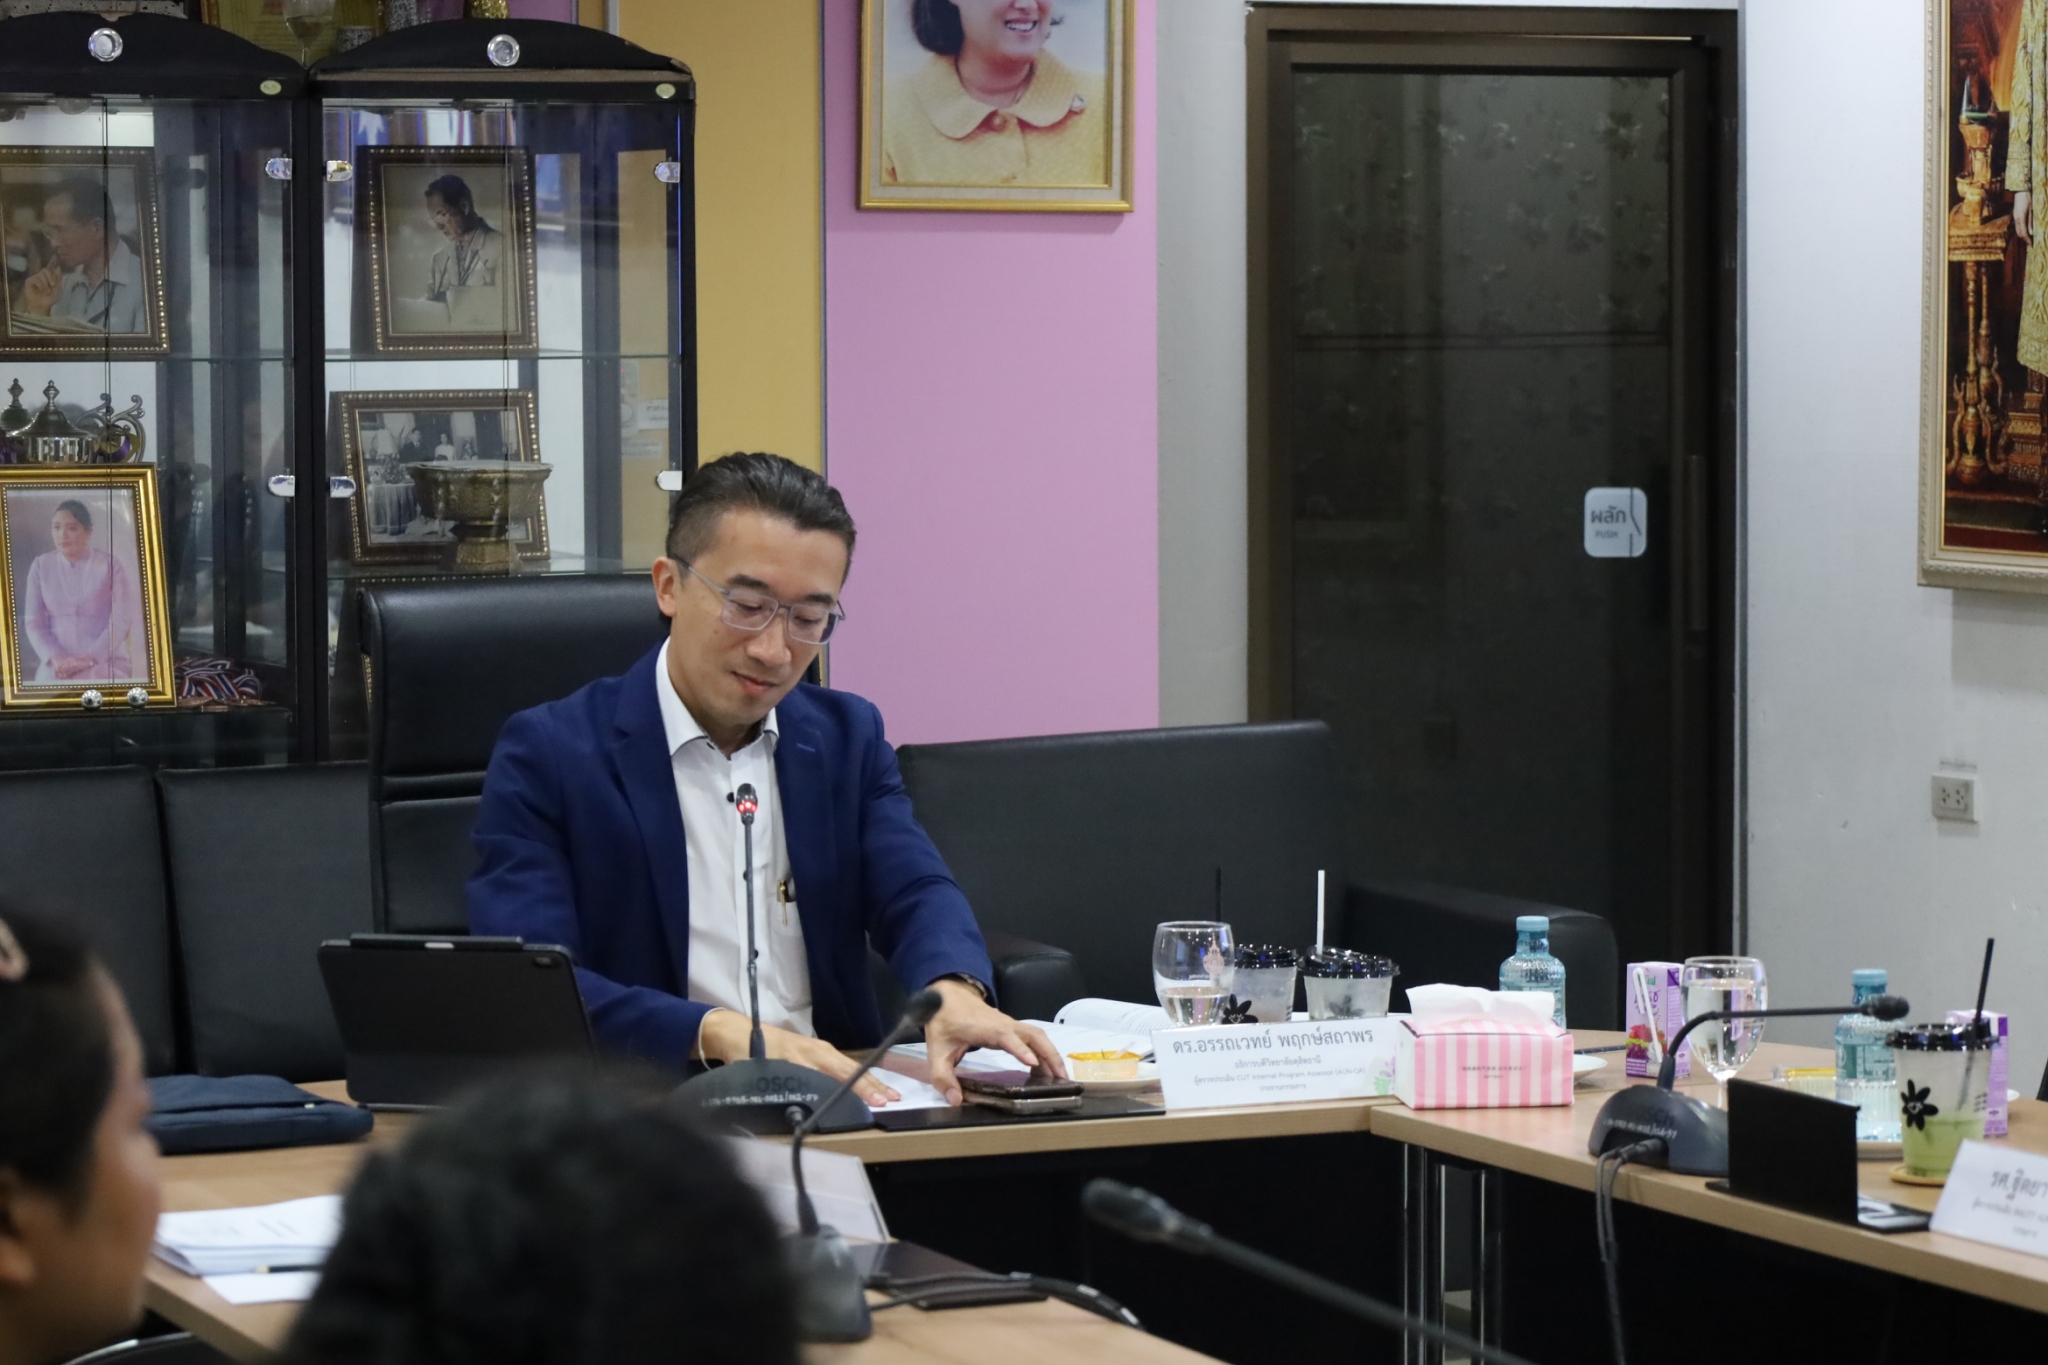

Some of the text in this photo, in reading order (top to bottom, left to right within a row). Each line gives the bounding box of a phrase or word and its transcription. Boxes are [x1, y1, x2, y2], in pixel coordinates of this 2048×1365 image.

[1590, 504, 1627, 524] ผลัก
[1594, 529, 1619, 539] PUSH
[1172, 1025, 1374, 1054] ดร.อรรถเวทย์ พฤกษ์สถาพร
[1252, 1072, 1277, 1080] Internal
[1278, 1071, 1305, 1080] Program
[1306, 1069, 1333, 1078] Assessor
